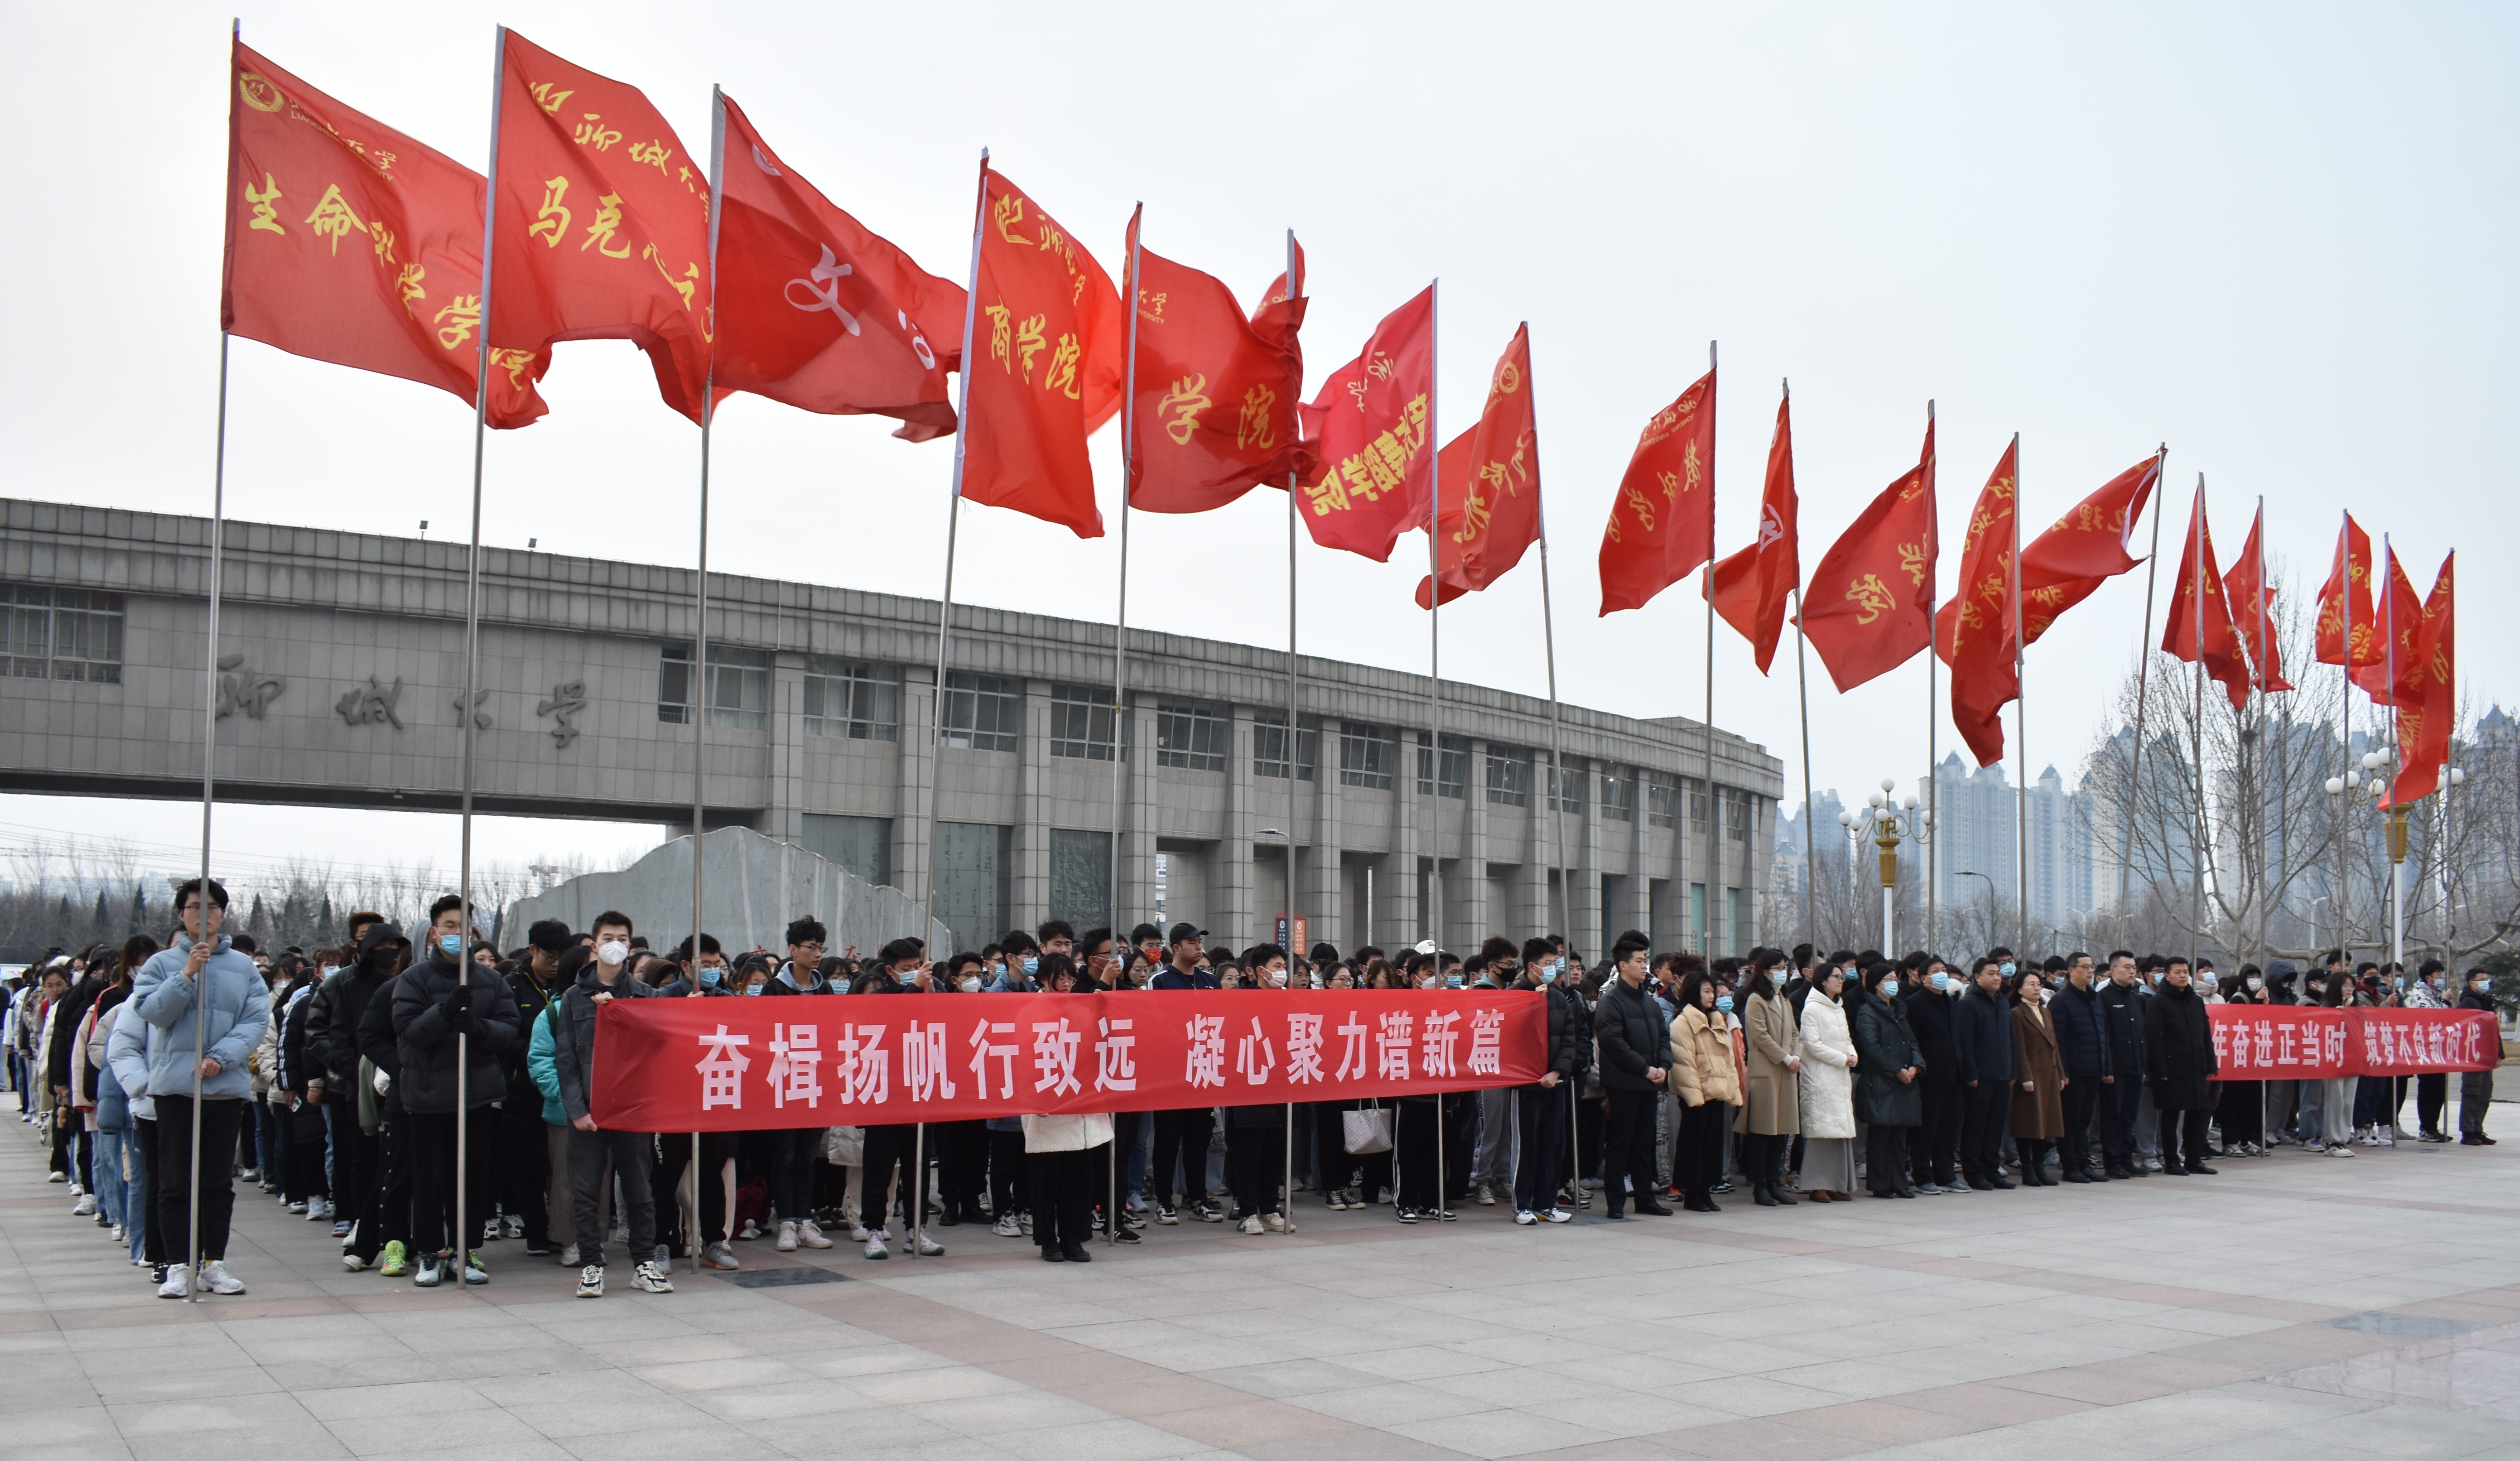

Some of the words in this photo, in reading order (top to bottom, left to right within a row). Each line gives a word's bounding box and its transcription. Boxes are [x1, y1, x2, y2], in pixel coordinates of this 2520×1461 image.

[985, 296, 1080, 400] 商学院
[695, 1017, 1136, 1111] 奋楫扬帆行致远
[1185, 1008, 1504, 1090] 凝心聚力谱新篇
[2364, 1021, 2481, 1066] 筑梦不负新时代
